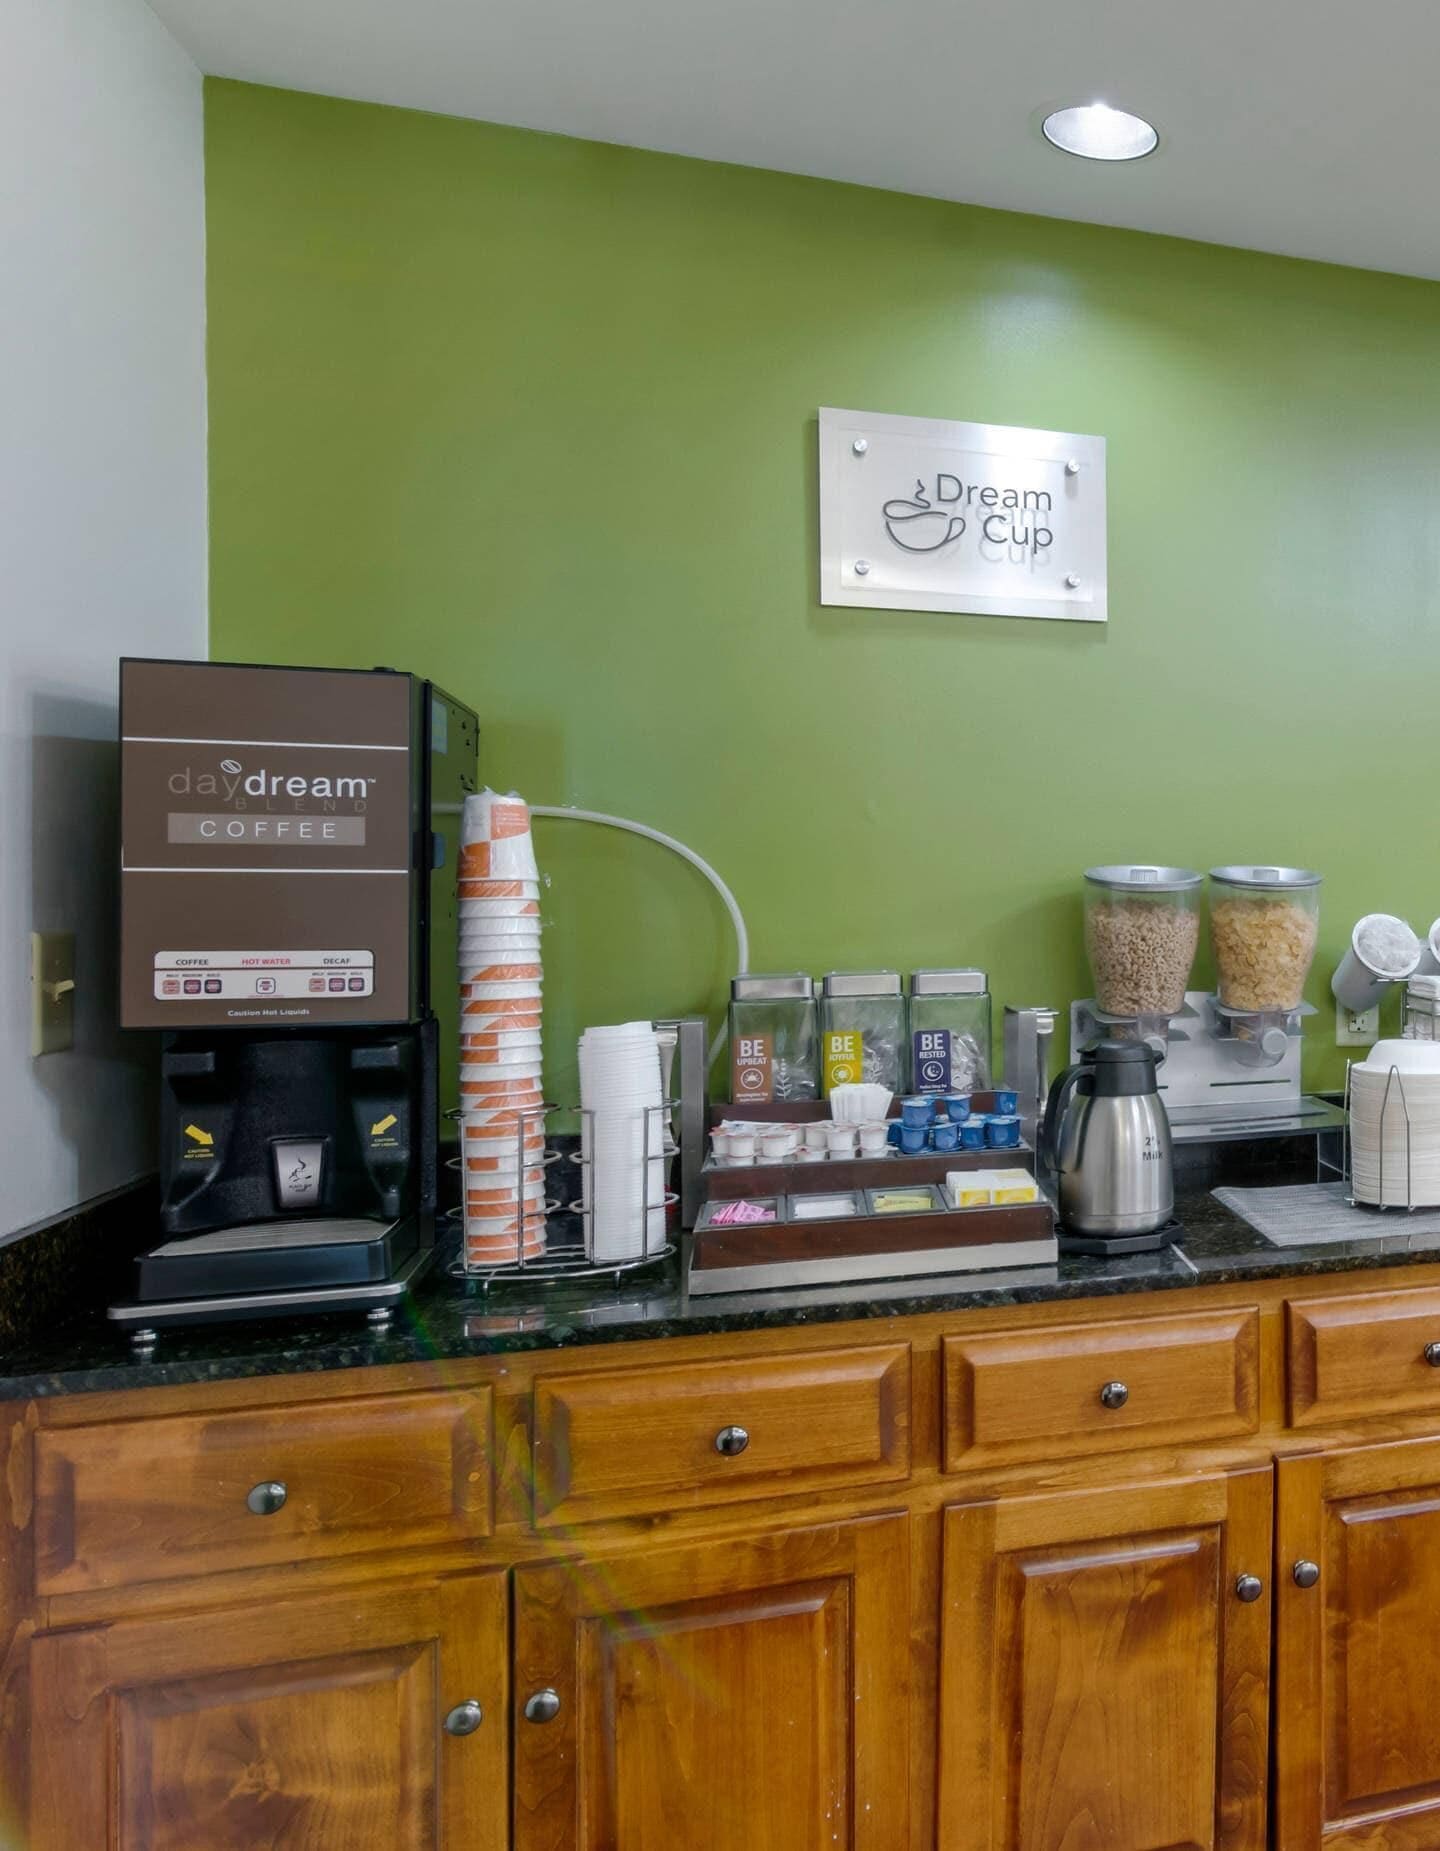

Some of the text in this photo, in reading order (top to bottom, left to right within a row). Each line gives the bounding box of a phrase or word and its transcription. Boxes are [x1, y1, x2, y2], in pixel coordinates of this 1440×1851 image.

[936, 473, 1052, 511] Dream
[982, 514, 1054, 554] Cup
[235, 797, 367, 812] BLEND
[200, 820, 337, 839] COFFEE
[175, 958, 209, 966] COFFEE
[323, 957, 351, 965] DECAF
[280, 1008, 310, 1017] Liquids
[740, 1040, 764, 1057] BE
[831, 1036, 854, 1053] BE
[921, 1033, 943, 1051] BE
[736, 1057, 768, 1066] UPBEAT
[919, 1050, 946, 1059] RESTED
[1142, 1150, 1164, 1161] Milk
